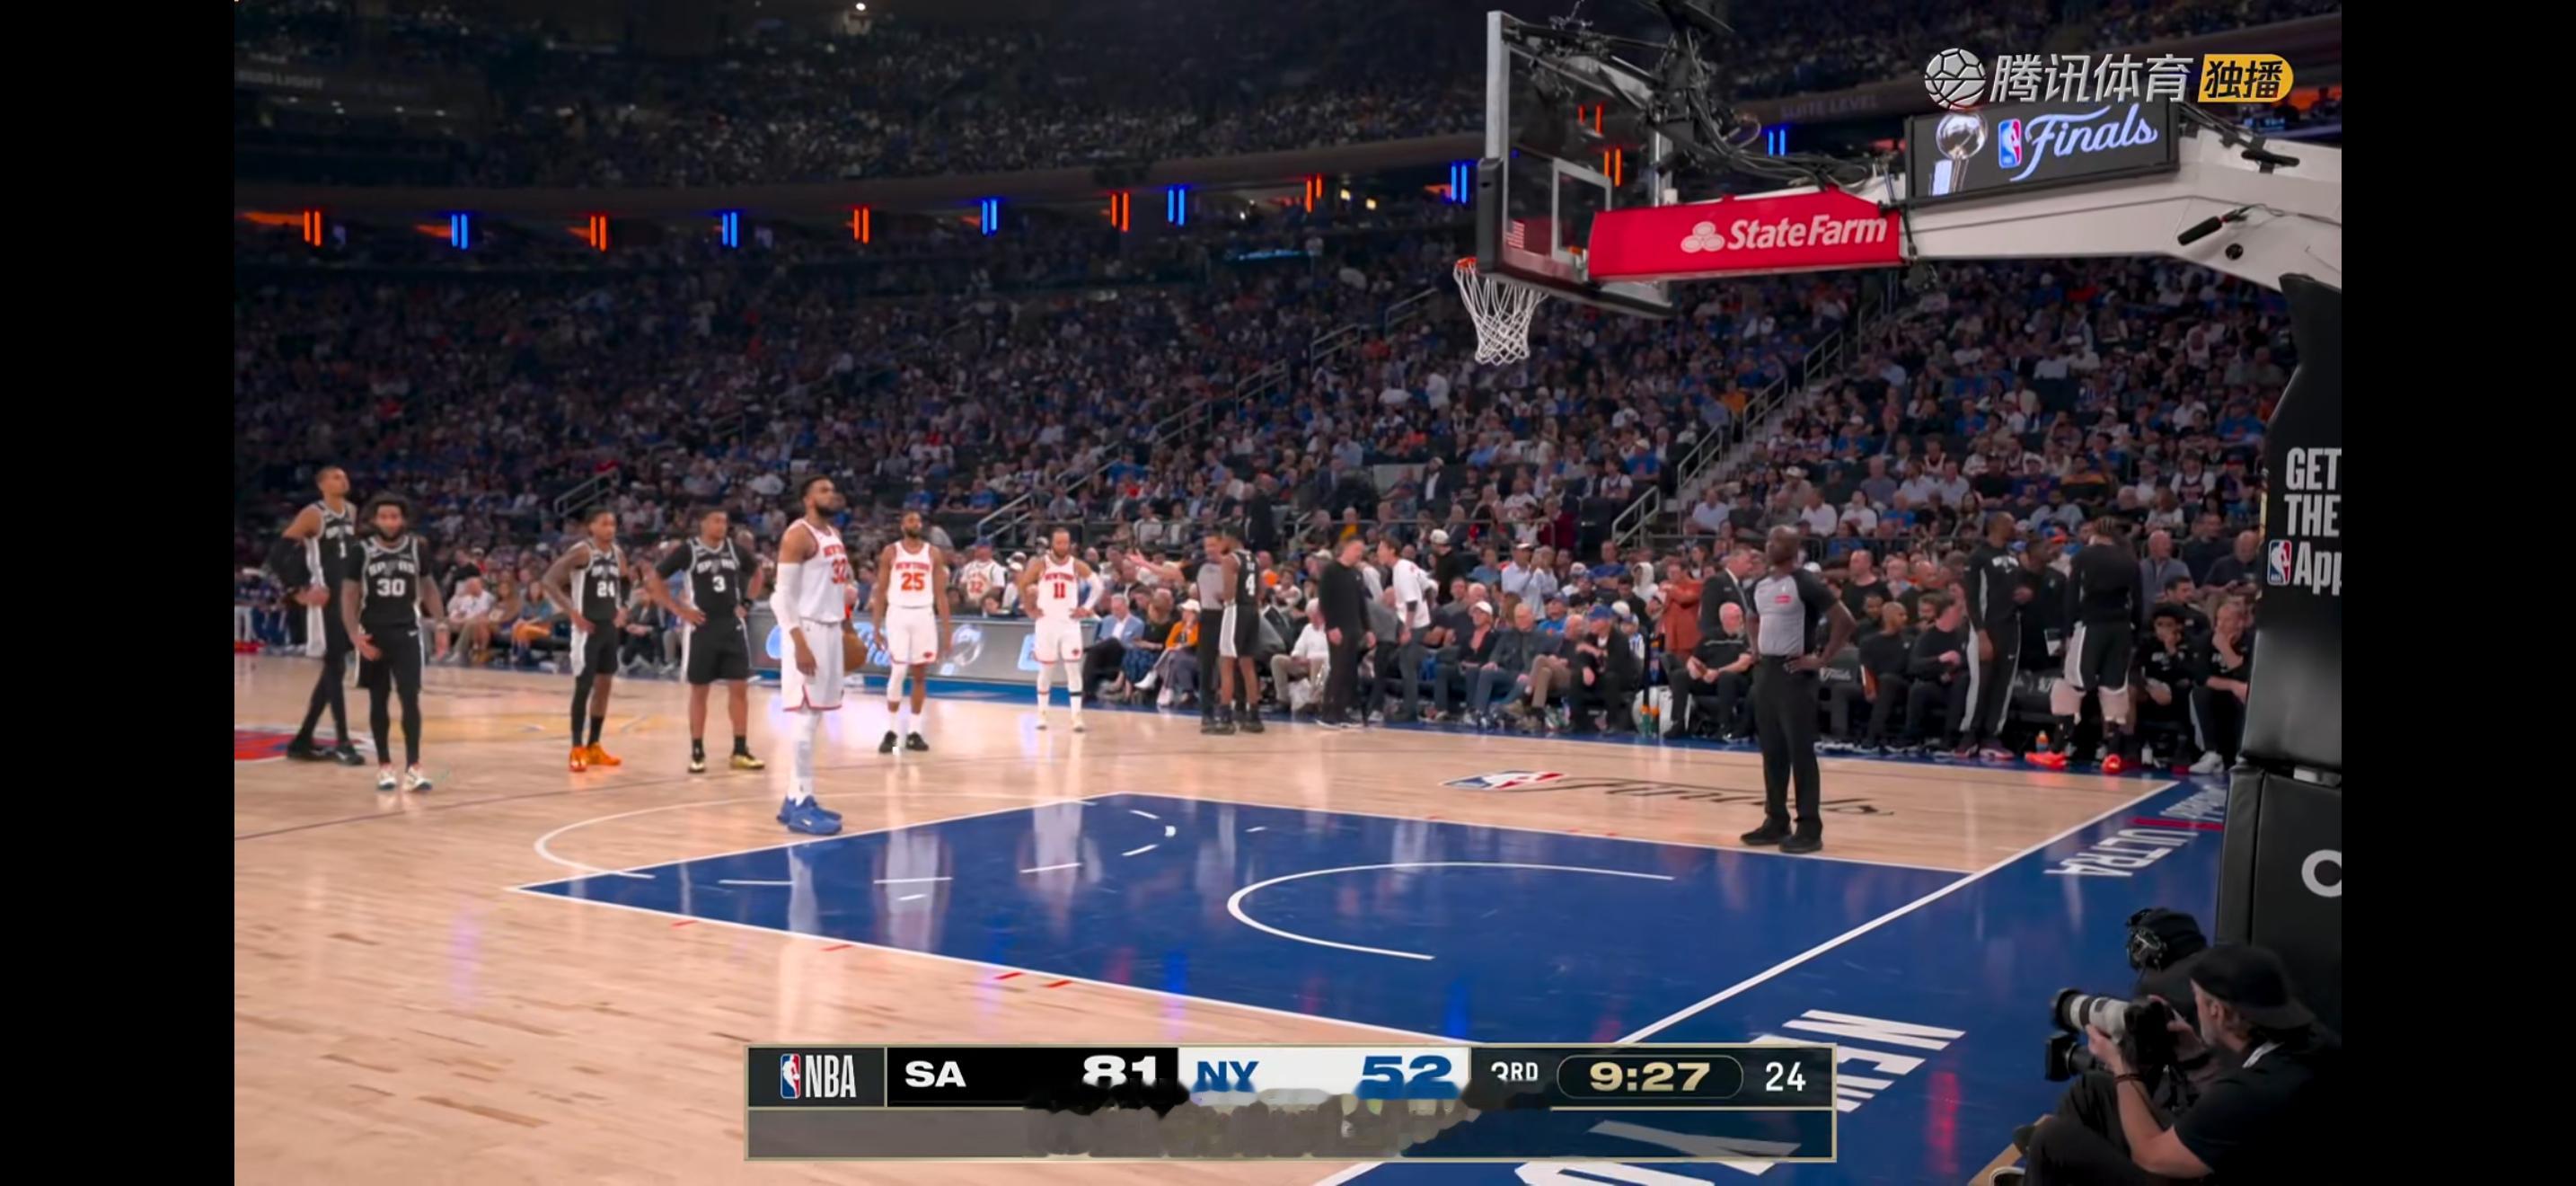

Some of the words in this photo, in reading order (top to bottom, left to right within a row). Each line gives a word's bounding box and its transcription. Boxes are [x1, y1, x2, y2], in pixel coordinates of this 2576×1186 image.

[1829, 94, 1879, 114] LEVEL
[2010, 103, 2157, 181] Finals
[2286, 447, 2342, 491] GET
[2284, 494, 2342, 536] THE
[377, 578, 405, 597] 30
[712, 576, 725, 592] 3
[901, 572, 924, 591] 25
[1054, 582, 1065, 599] 11
[2043, 828, 2199, 877] ULTRA
